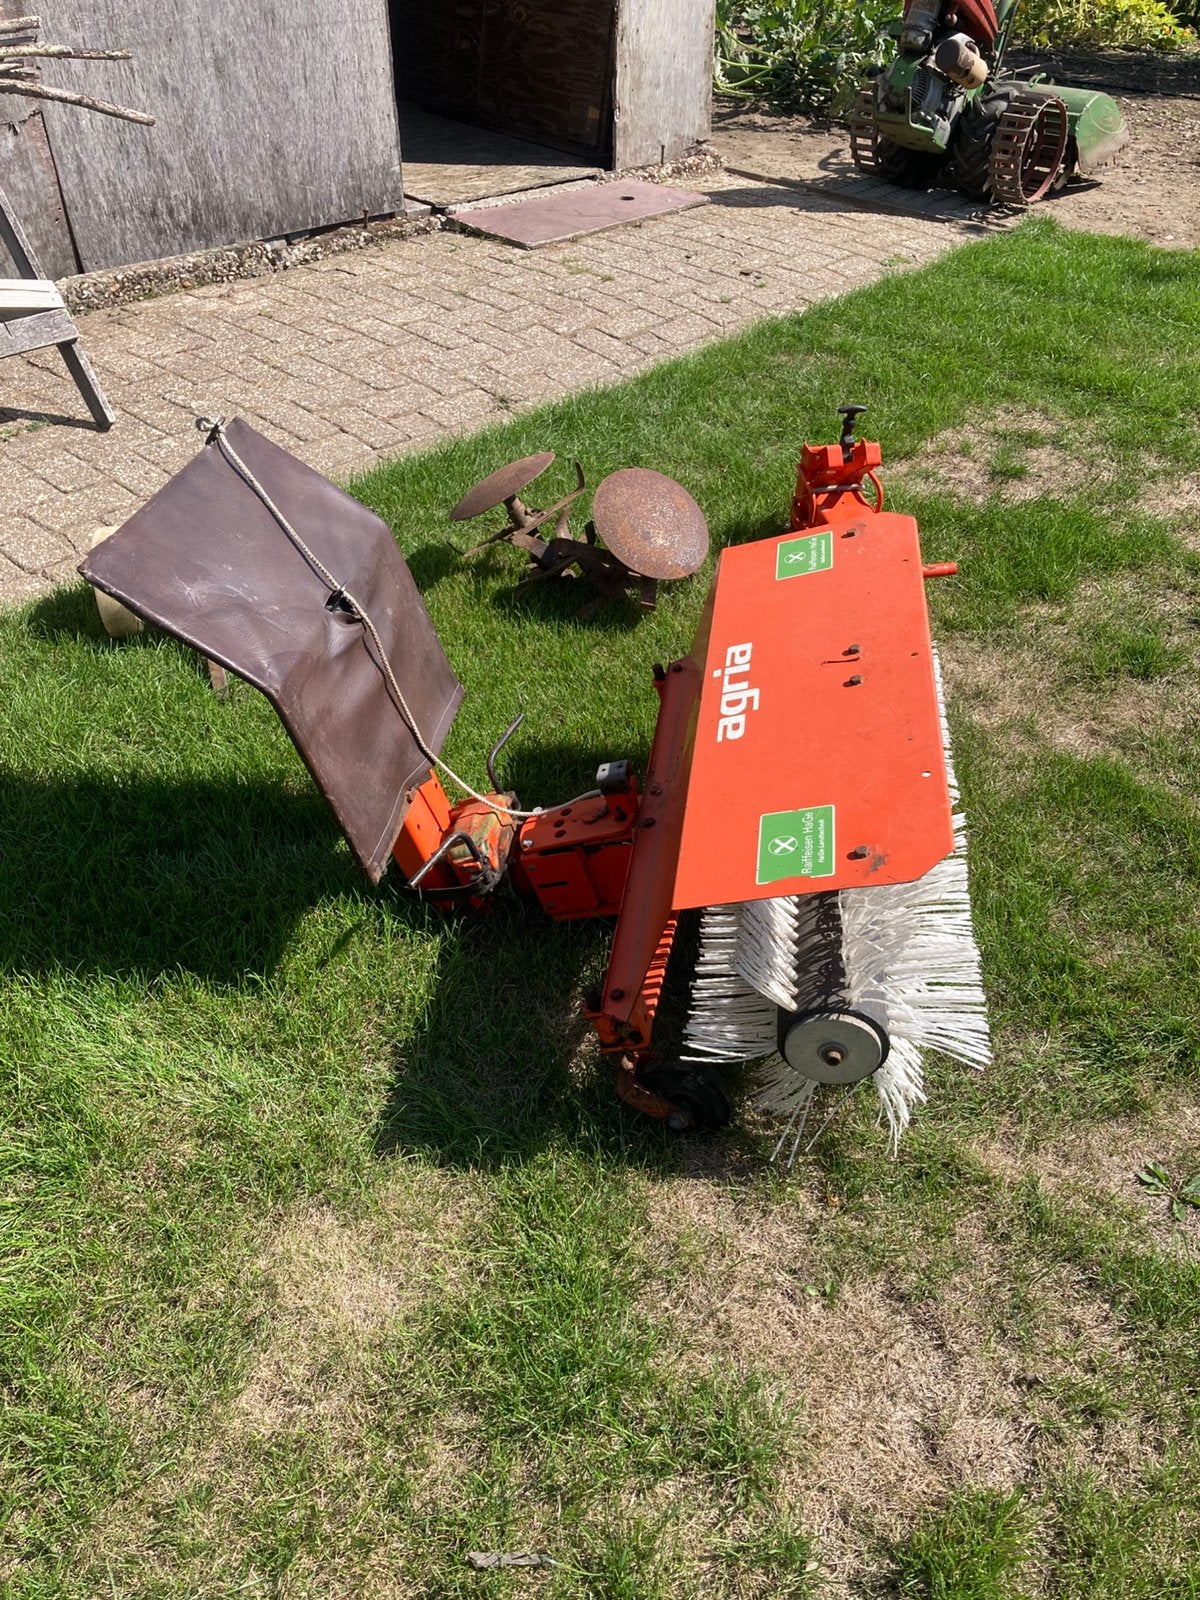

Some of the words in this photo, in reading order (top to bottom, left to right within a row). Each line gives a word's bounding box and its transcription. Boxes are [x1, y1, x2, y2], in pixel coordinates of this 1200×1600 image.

[713, 642, 760, 743] agria
[802, 812, 813, 833] HaGe
[801, 835, 813, 874] Raiffeisen
